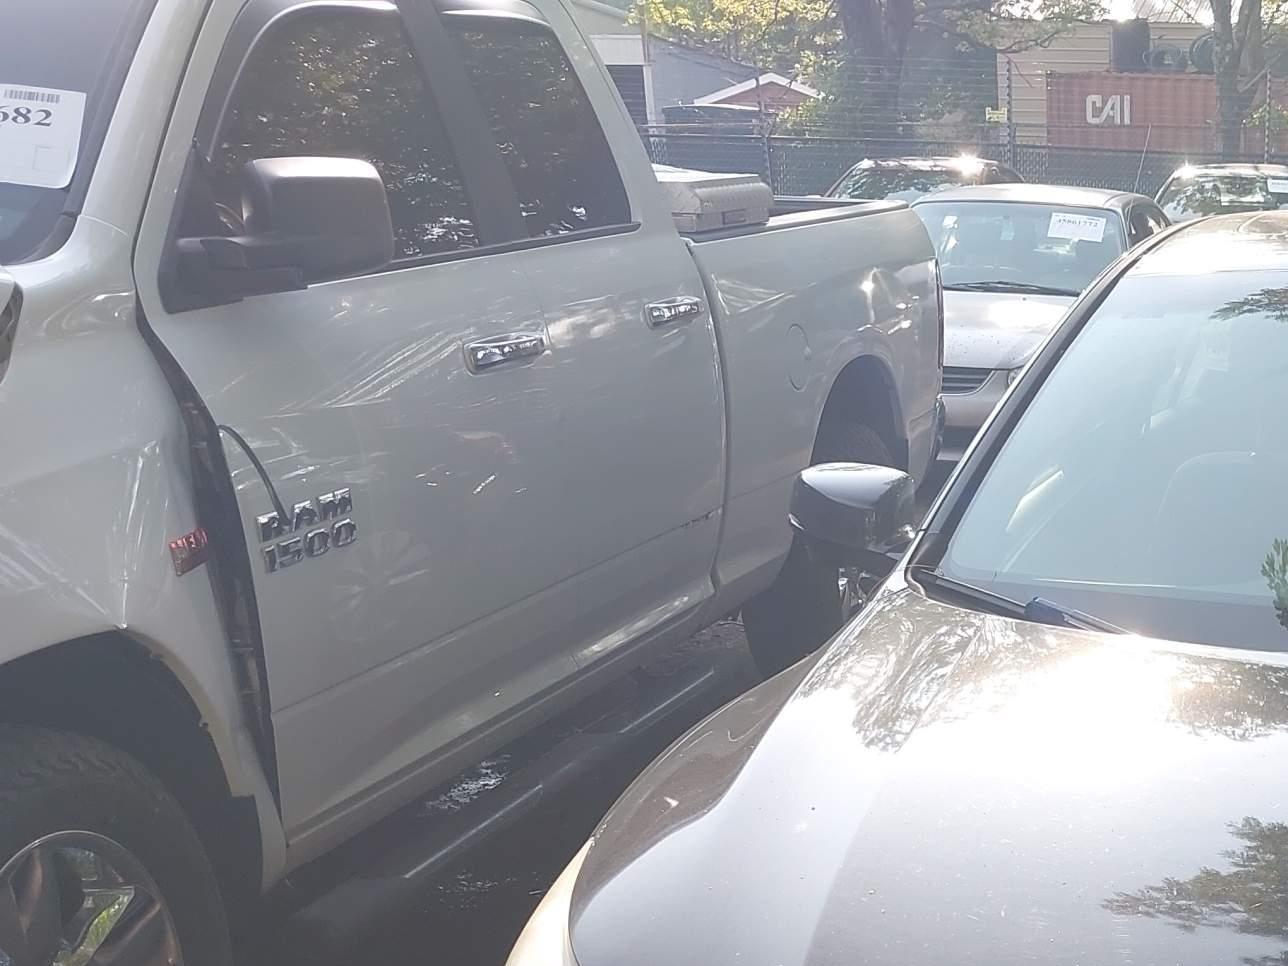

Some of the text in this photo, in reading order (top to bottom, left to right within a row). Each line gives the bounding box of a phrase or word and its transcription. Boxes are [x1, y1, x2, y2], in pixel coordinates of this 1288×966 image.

[1086, 94, 1131, 125] CAI
[256, 487, 353, 544] RAM
[263, 519, 357, 574] 1500
